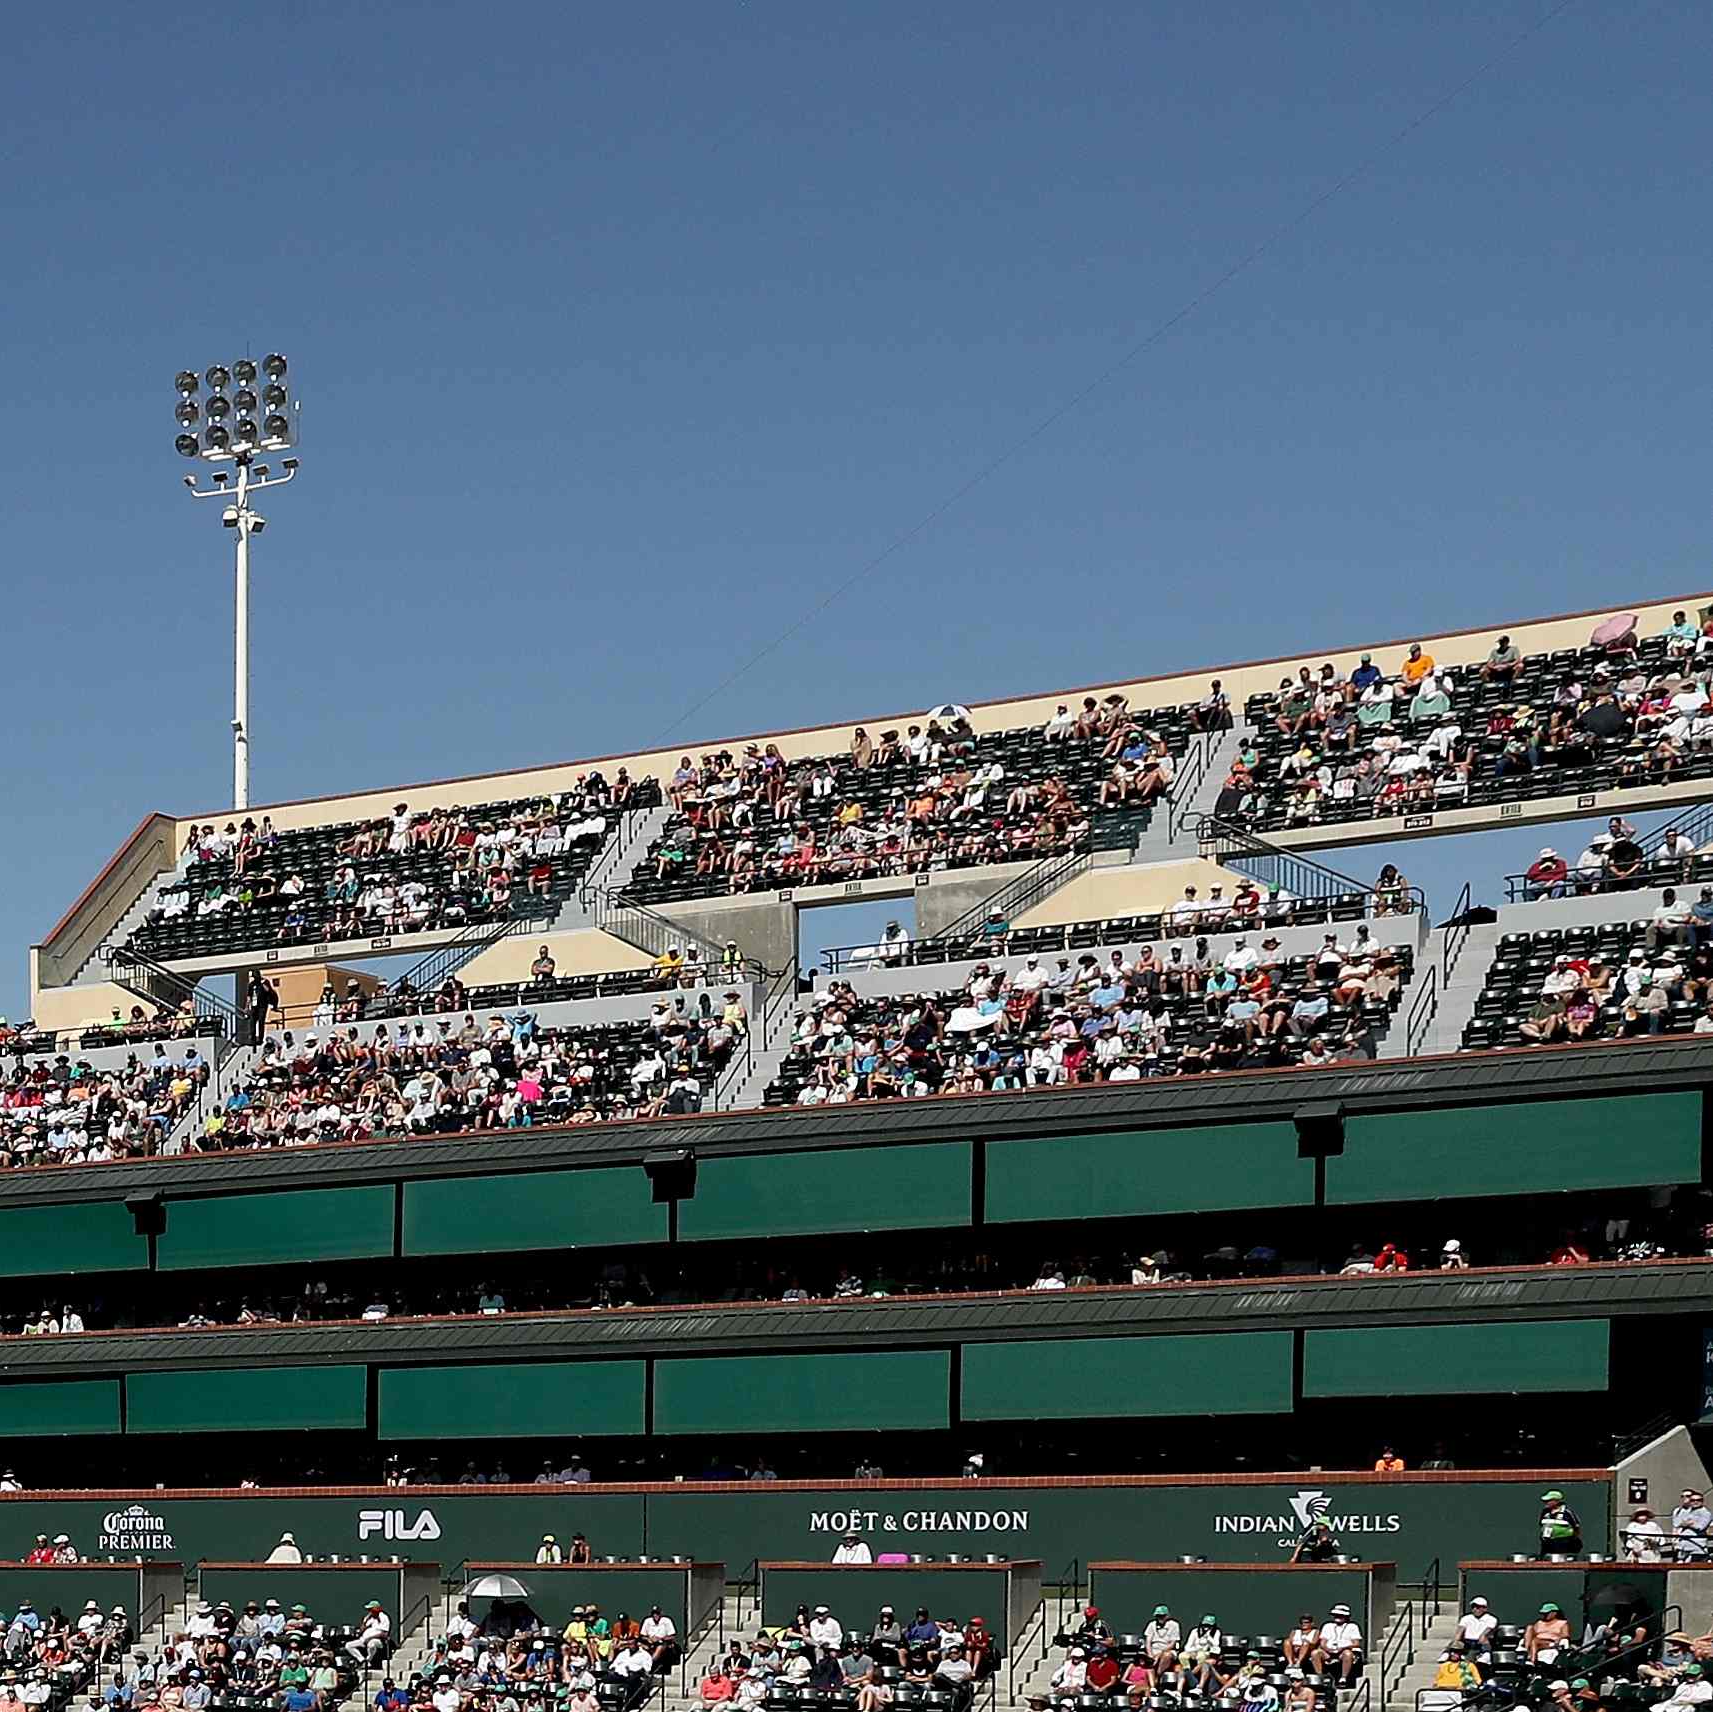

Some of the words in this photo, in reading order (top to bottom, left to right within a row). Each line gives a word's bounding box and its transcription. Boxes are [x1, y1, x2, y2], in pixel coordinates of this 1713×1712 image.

[103, 1512, 165, 1536] Corona
[359, 1509, 441, 1541] FILA
[809, 1508, 879, 1531] MOËT
[883, 1514, 899, 1532] &
[902, 1510, 1028, 1532] CHANDON
[1214, 1516, 1295, 1534] INDIAN
[1323, 1514, 1401, 1533] WELLS
[99, 1534, 173, 1550] PREMIER
